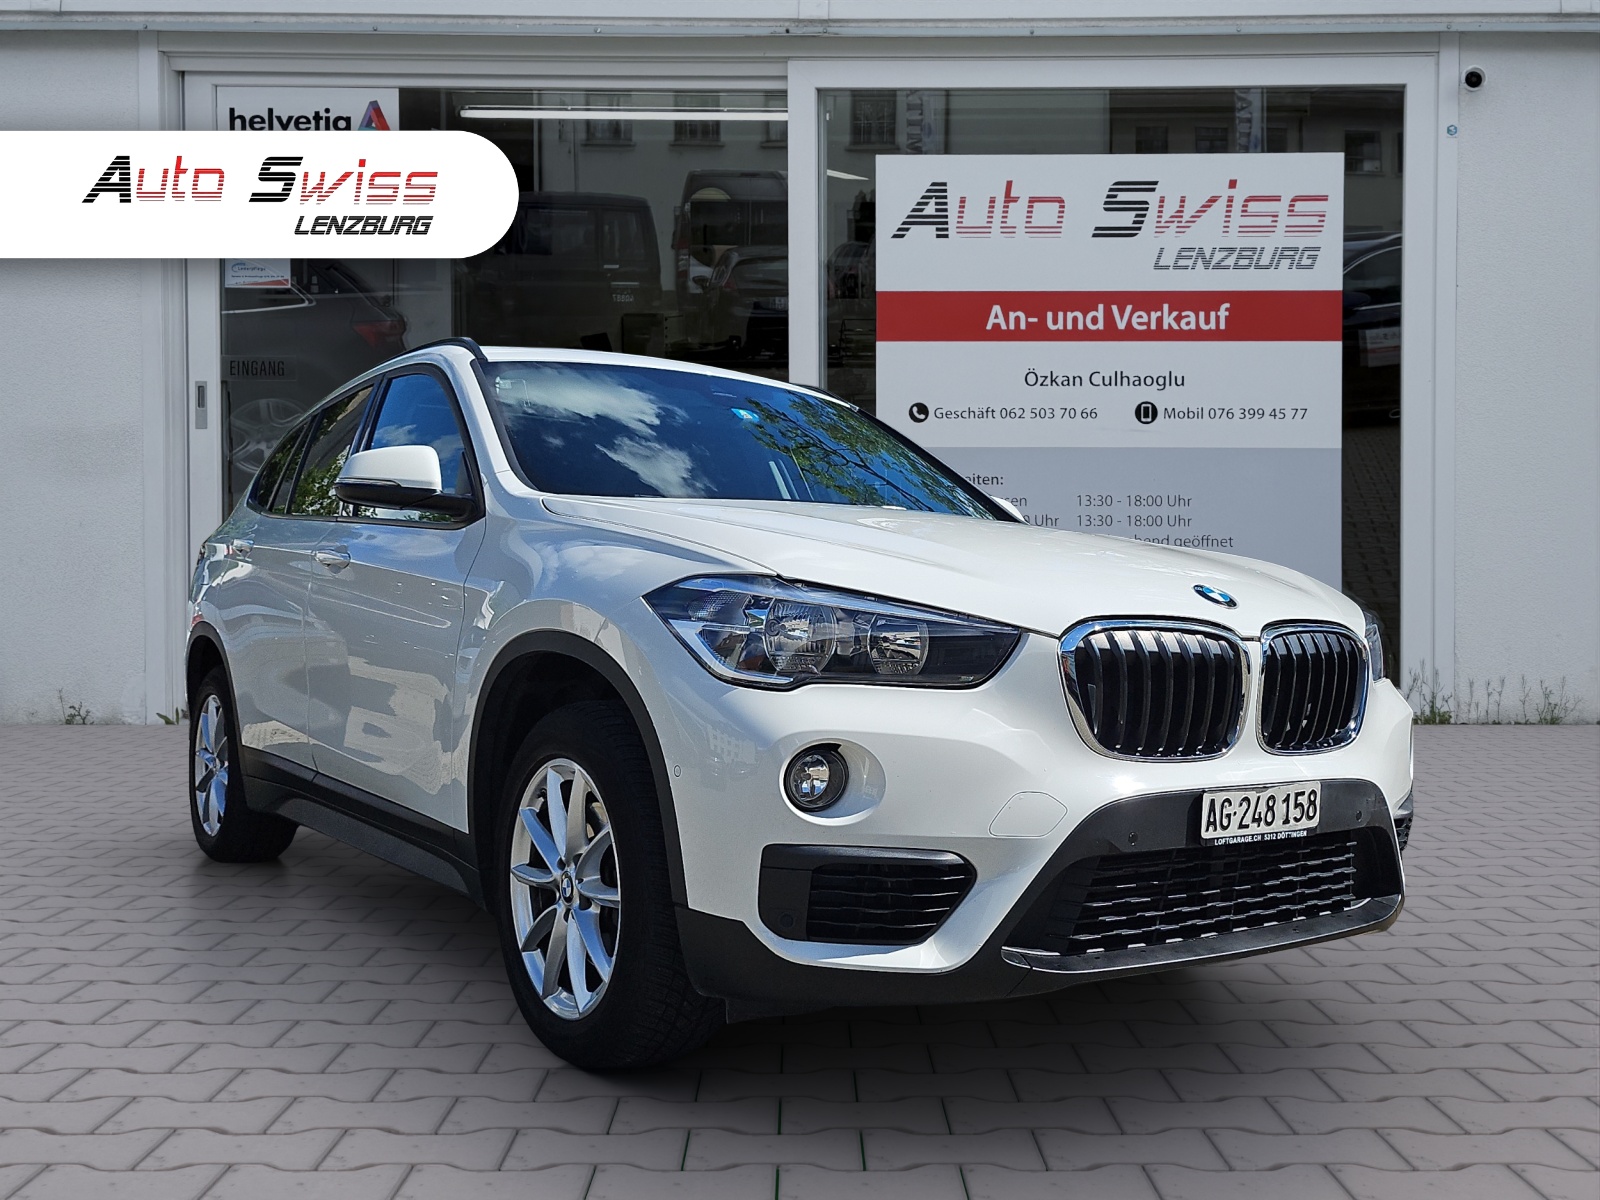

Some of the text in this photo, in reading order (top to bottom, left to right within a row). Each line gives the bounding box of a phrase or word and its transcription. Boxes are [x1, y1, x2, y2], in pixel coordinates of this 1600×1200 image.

[229, 107, 352, 131] helvetia
[891, 179, 1329, 239] Auto Swiss
[1153, 246, 1322, 270] LENZBURG
[986, 302, 1231, 331] An- und Verkauf
[229, 360, 285, 376] EINGANG
[1024, 367, 1186, 391] Özkan Culhaoglu
[933, 406, 1098, 420] Geschäft 062 503 70 66
[1163, 406, 1308, 420] Mobil 076 399 45 77
[1077, 494, 1113, 507] 13:30
[1127, 494, 1163, 507] 18:00
[1167, 494, 1192, 507] Uhr
[1034, 513, 1060, 527] Uhr
[1077, 514, 1113, 527] 13:30
[1127, 514, 1163, 527] 18:00
[1167, 514, 1192, 527] Uhr
[1173, 534, 1234, 548] geöffnet
